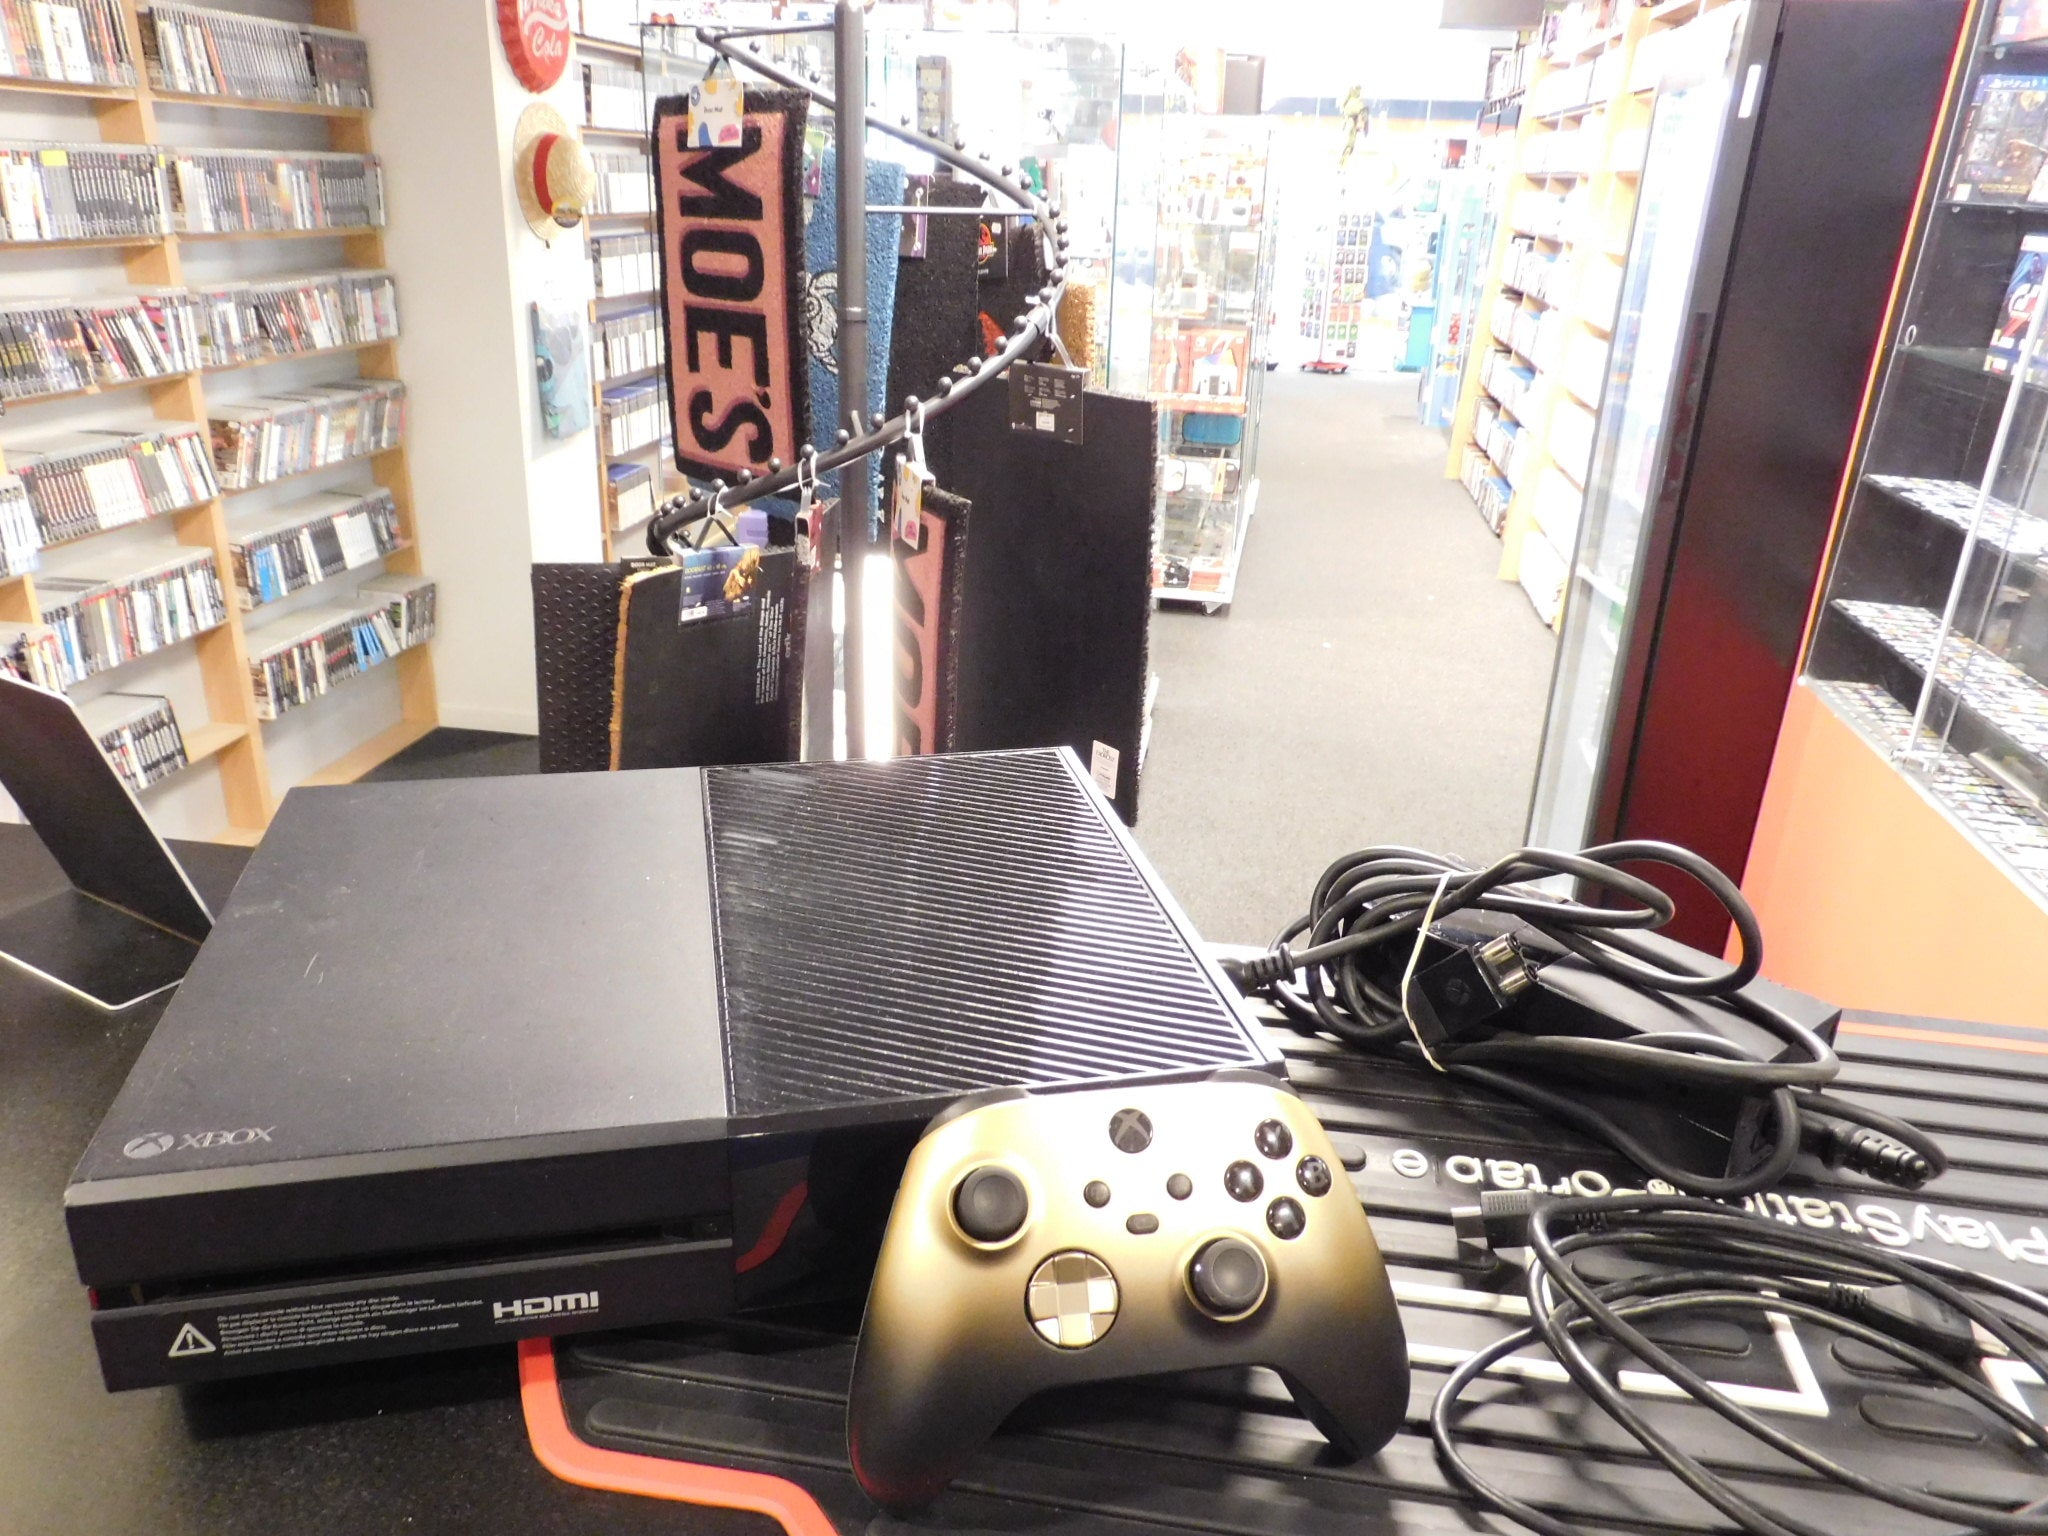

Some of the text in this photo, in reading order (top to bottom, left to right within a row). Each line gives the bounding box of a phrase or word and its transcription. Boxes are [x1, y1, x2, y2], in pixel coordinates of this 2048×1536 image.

[676, 126, 775, 464] MOE'S
[177, 1126, 277, 1151] XBOX
[1263, 1124, 1282, 1153] Y
[1304, 1160, 1329, 1190] B
[493, 1290, 599, 1319] HDMI
